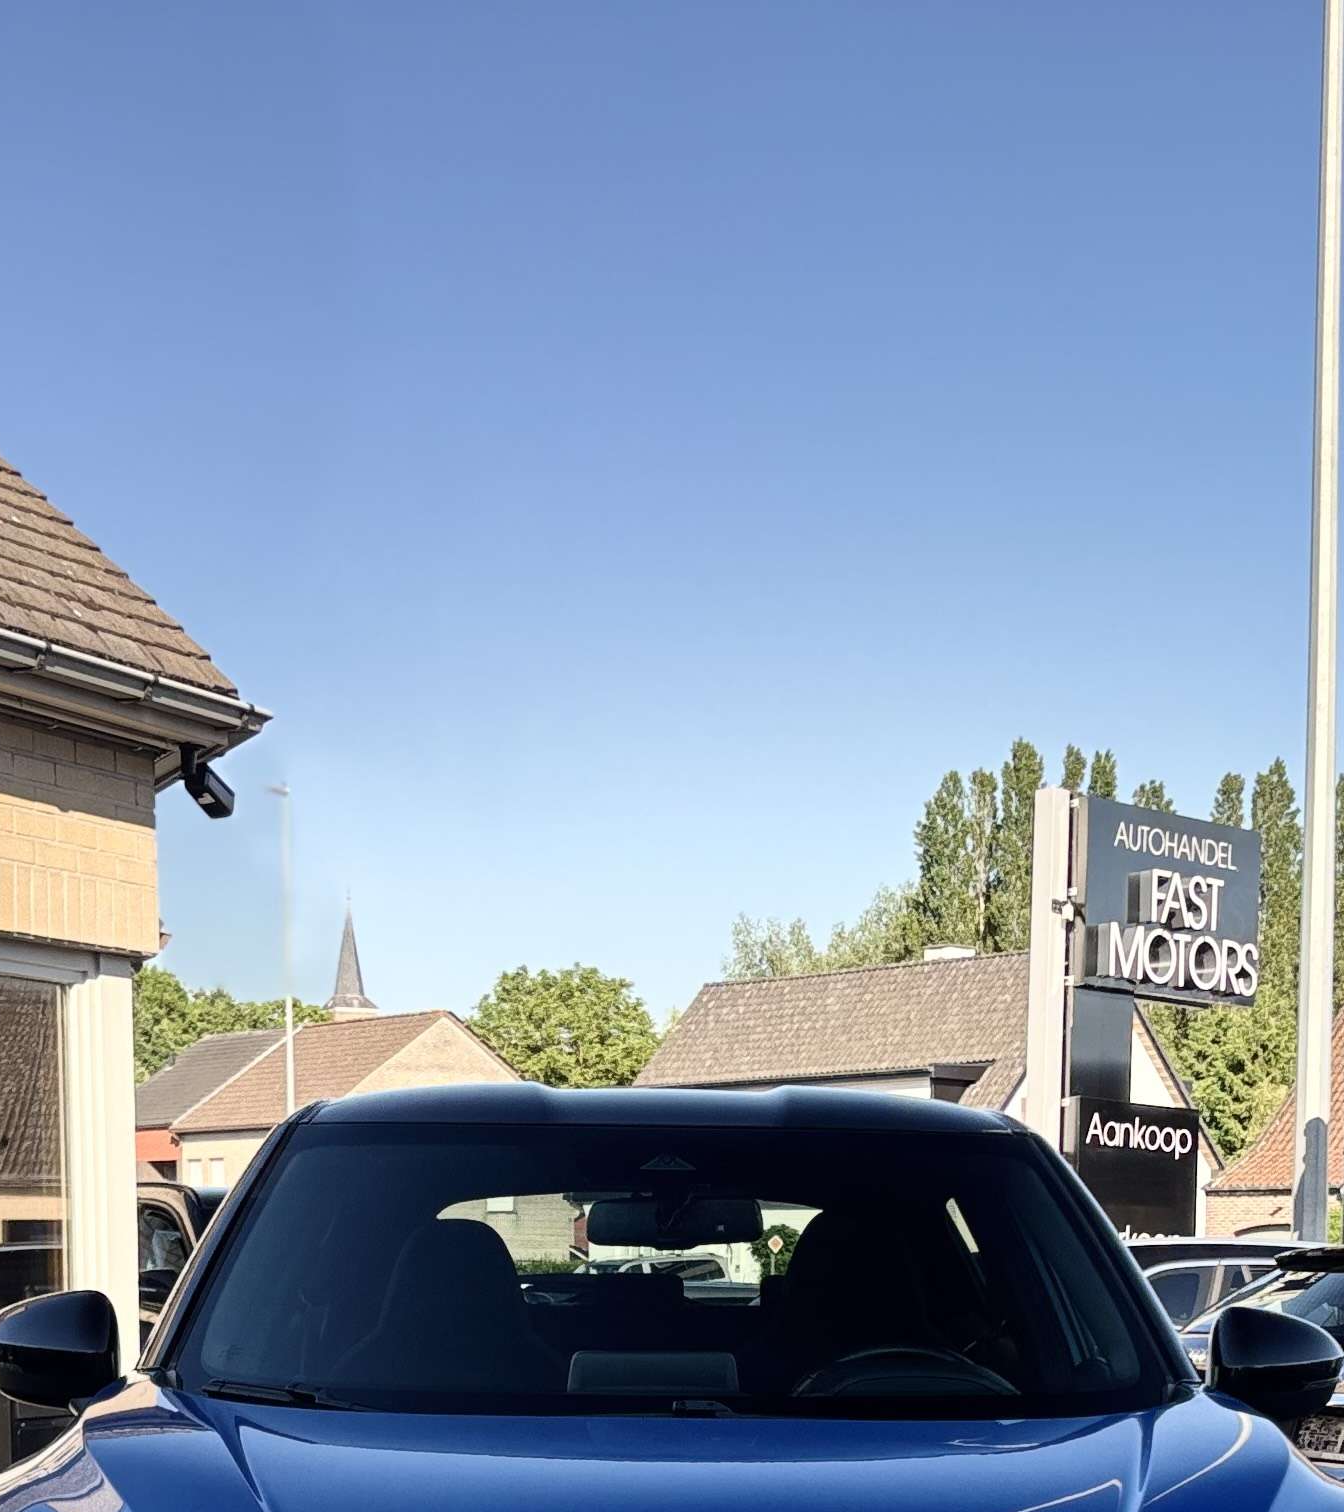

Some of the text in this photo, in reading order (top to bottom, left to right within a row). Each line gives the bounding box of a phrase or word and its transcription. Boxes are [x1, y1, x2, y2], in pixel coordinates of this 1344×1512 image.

[1114, 821, 1238, 871] AUTOHANDEL
[1150, 869, 1225, 932] FAST
[1109, 921, 1259, 997] MOTORS
[1086, 1112, 1193, 1160] Aankoop
